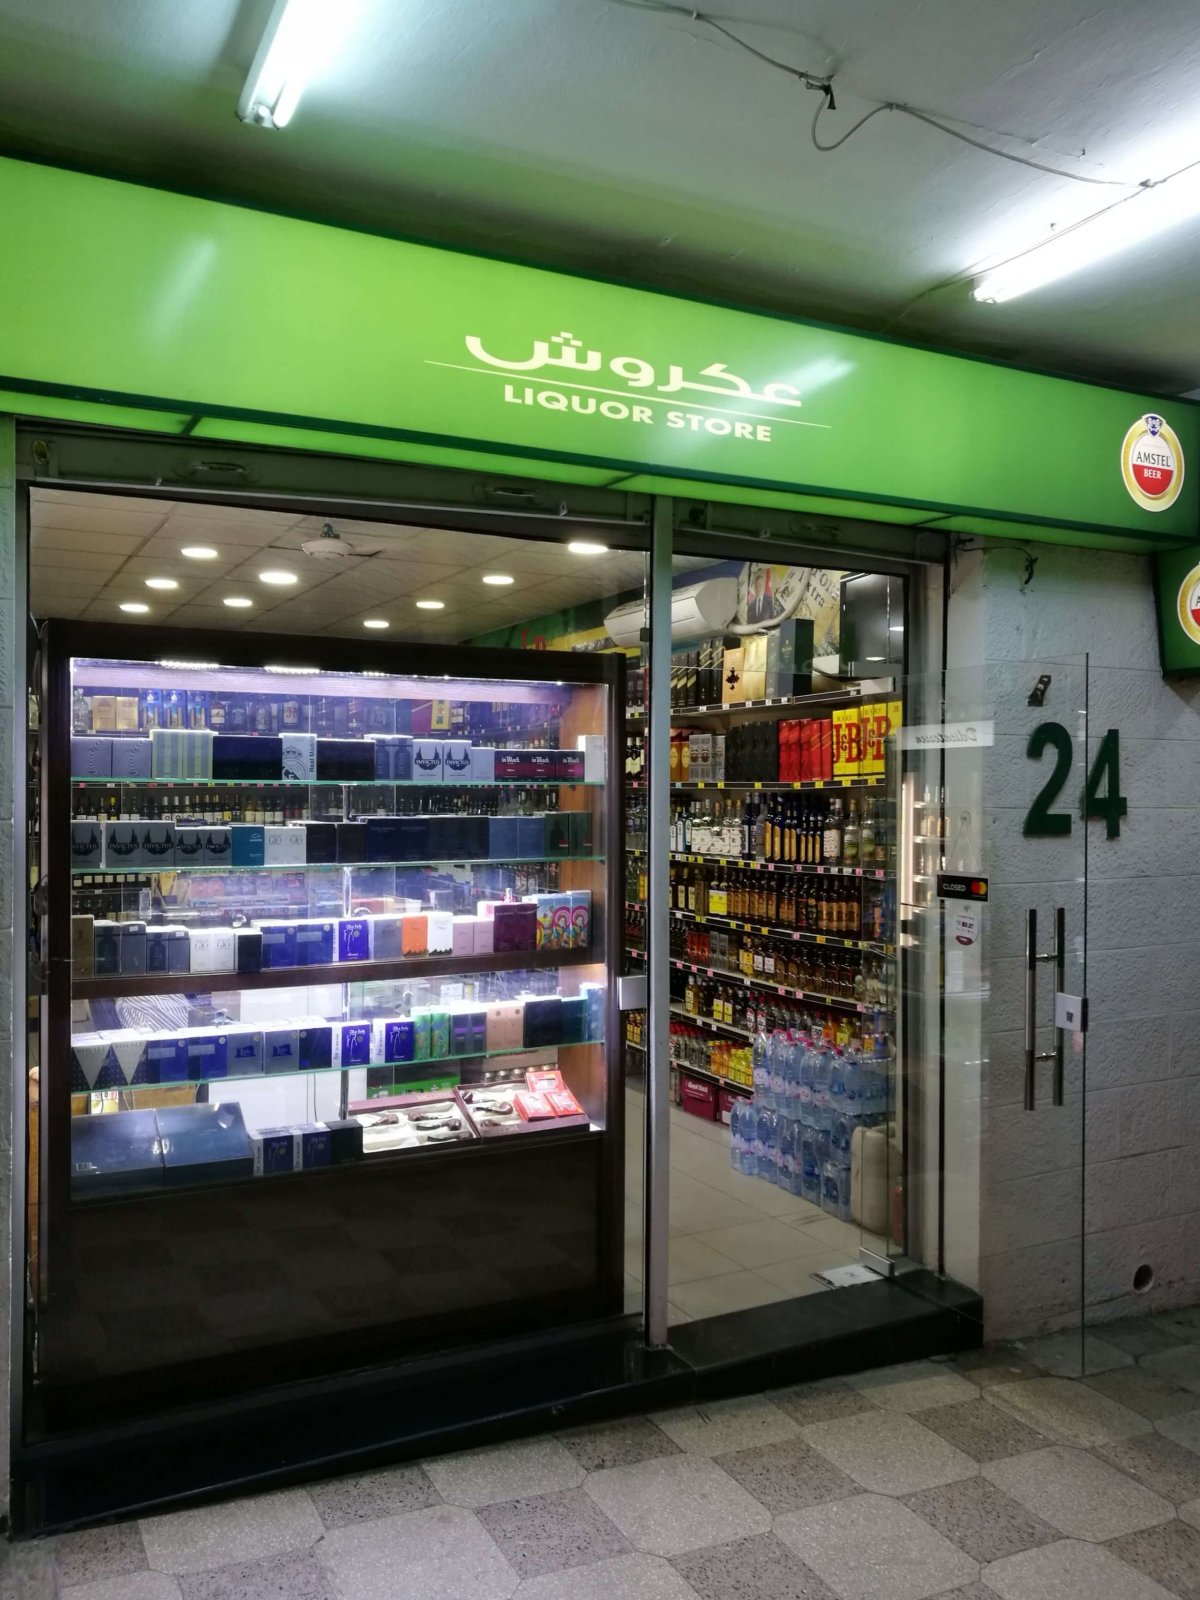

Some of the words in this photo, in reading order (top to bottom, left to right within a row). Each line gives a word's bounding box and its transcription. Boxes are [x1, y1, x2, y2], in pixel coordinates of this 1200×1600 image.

[465, 331, 802, 407] عكروش
[503, 384, 655, 426] LIQUOR
[666, 410, 772, 443] STORE
[1135, 451, 1171, 467] AMSTEL
[1143, 468, 1162, 480] BEER
[1022, 721, 1128, 838] 24
[942, 882, 966, 892] CLOSED
